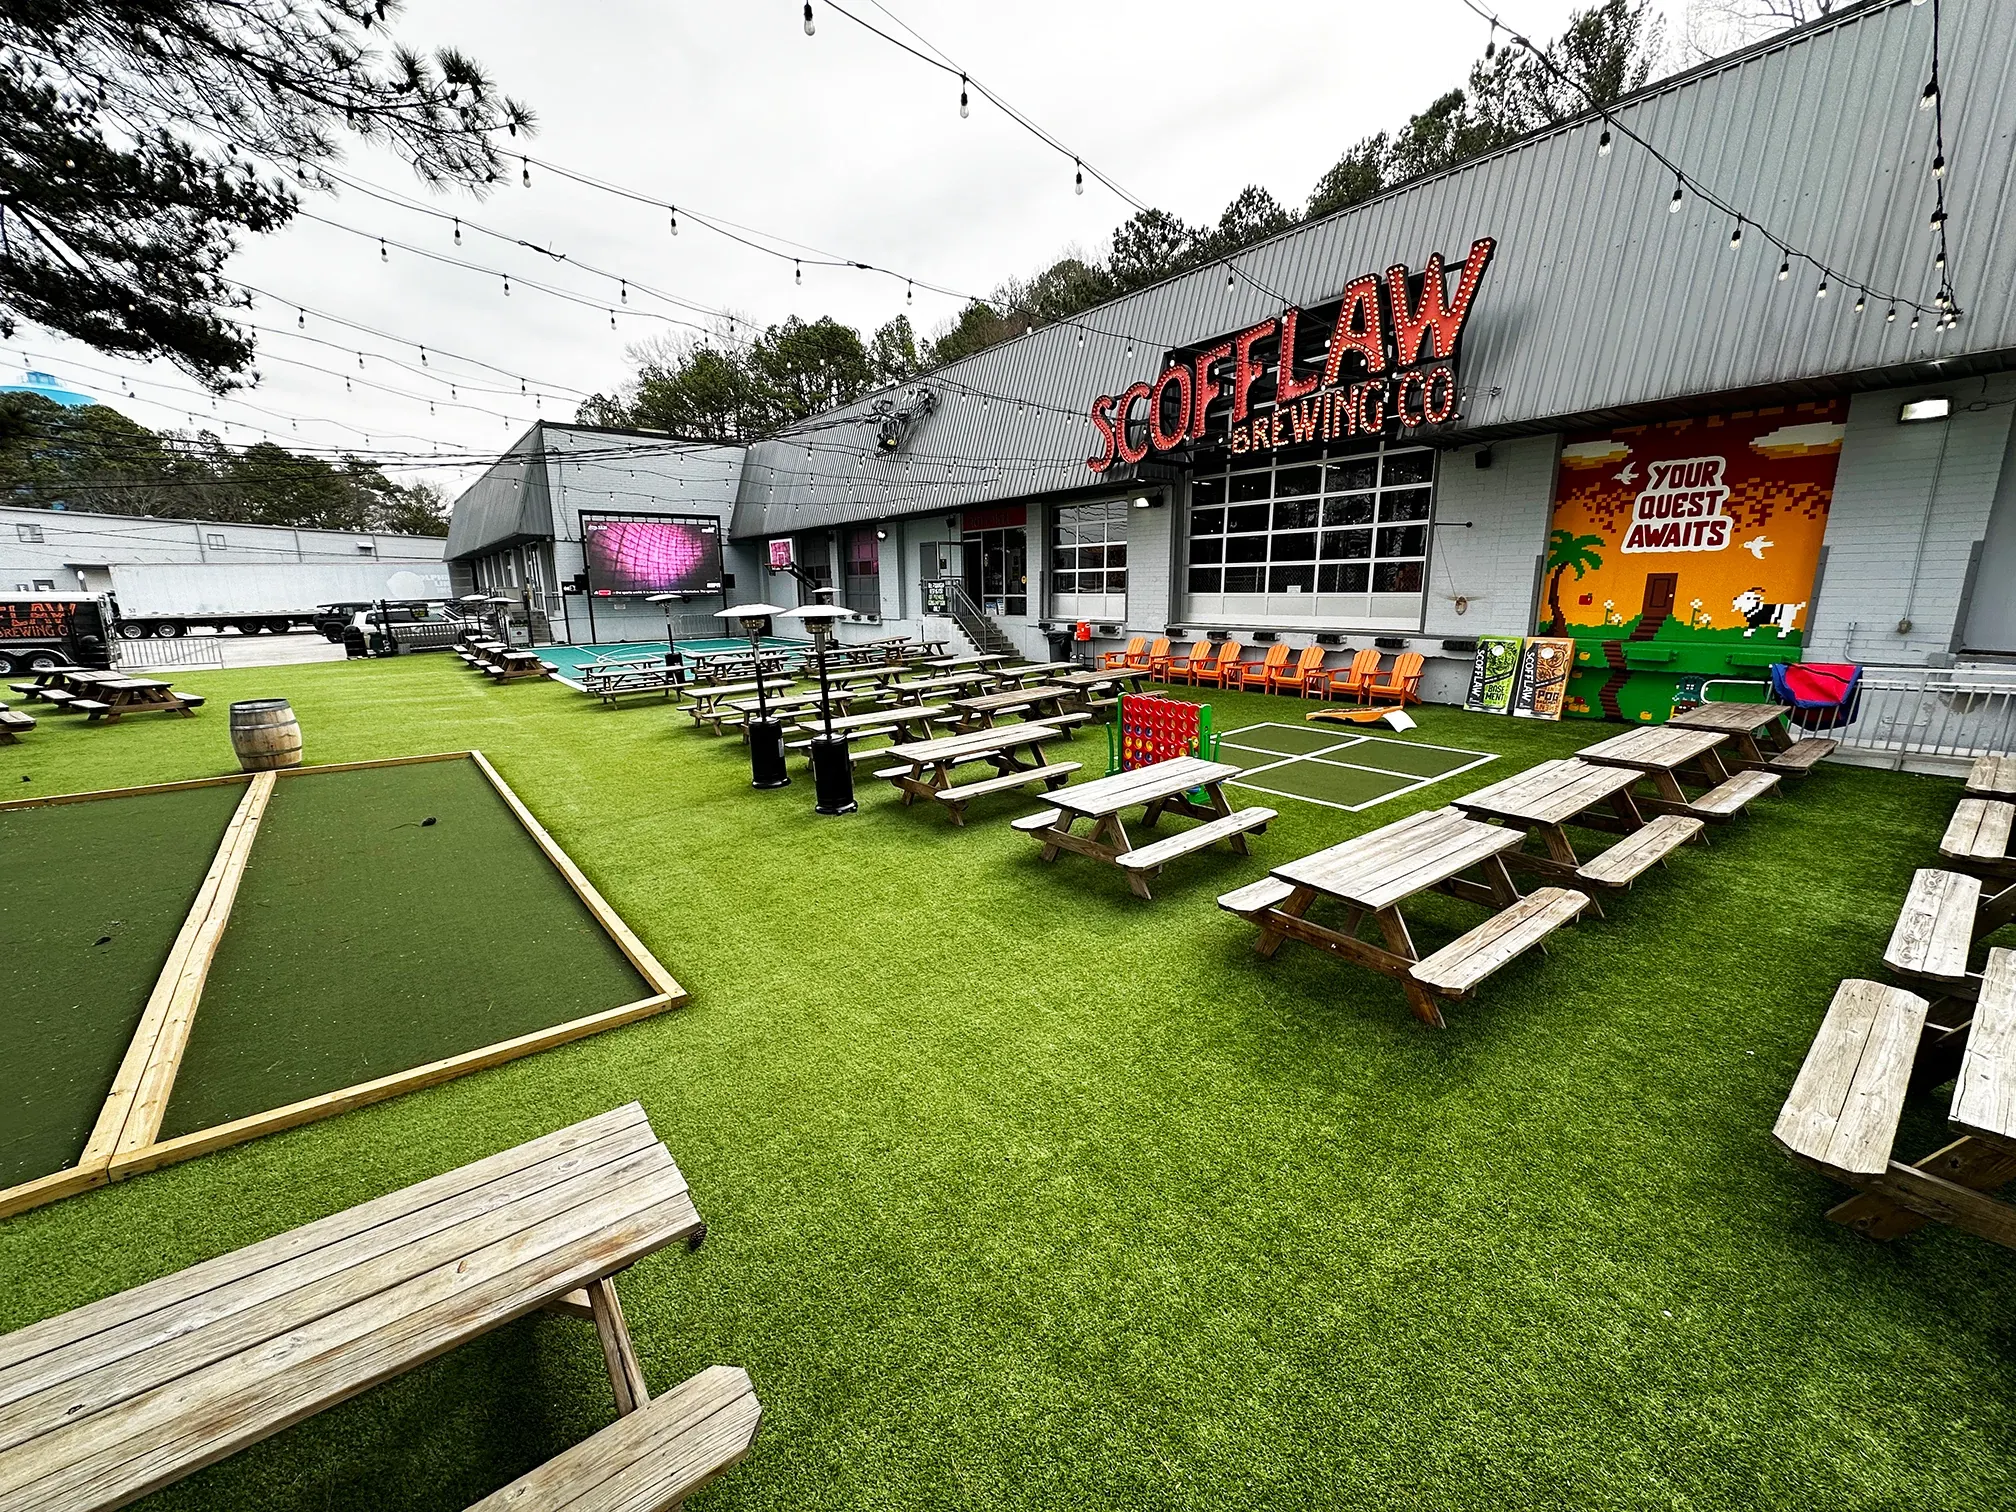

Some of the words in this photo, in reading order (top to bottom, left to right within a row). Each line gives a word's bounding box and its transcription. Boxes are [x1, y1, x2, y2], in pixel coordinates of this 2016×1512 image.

[1087, 236, 1497, 473] SCOFFLAW
[1232, 378, 1385, 455] BREWING
[1652, 460, 1721, 490] YOUR
[1638, 489, 1724, 520] QUEST
[1626, 520, 1727, 549] AWAITS
[1472, 649, 1485, 697] SCOFFLAW
[1522, 651, 1535, 702] SCOFFLAW
